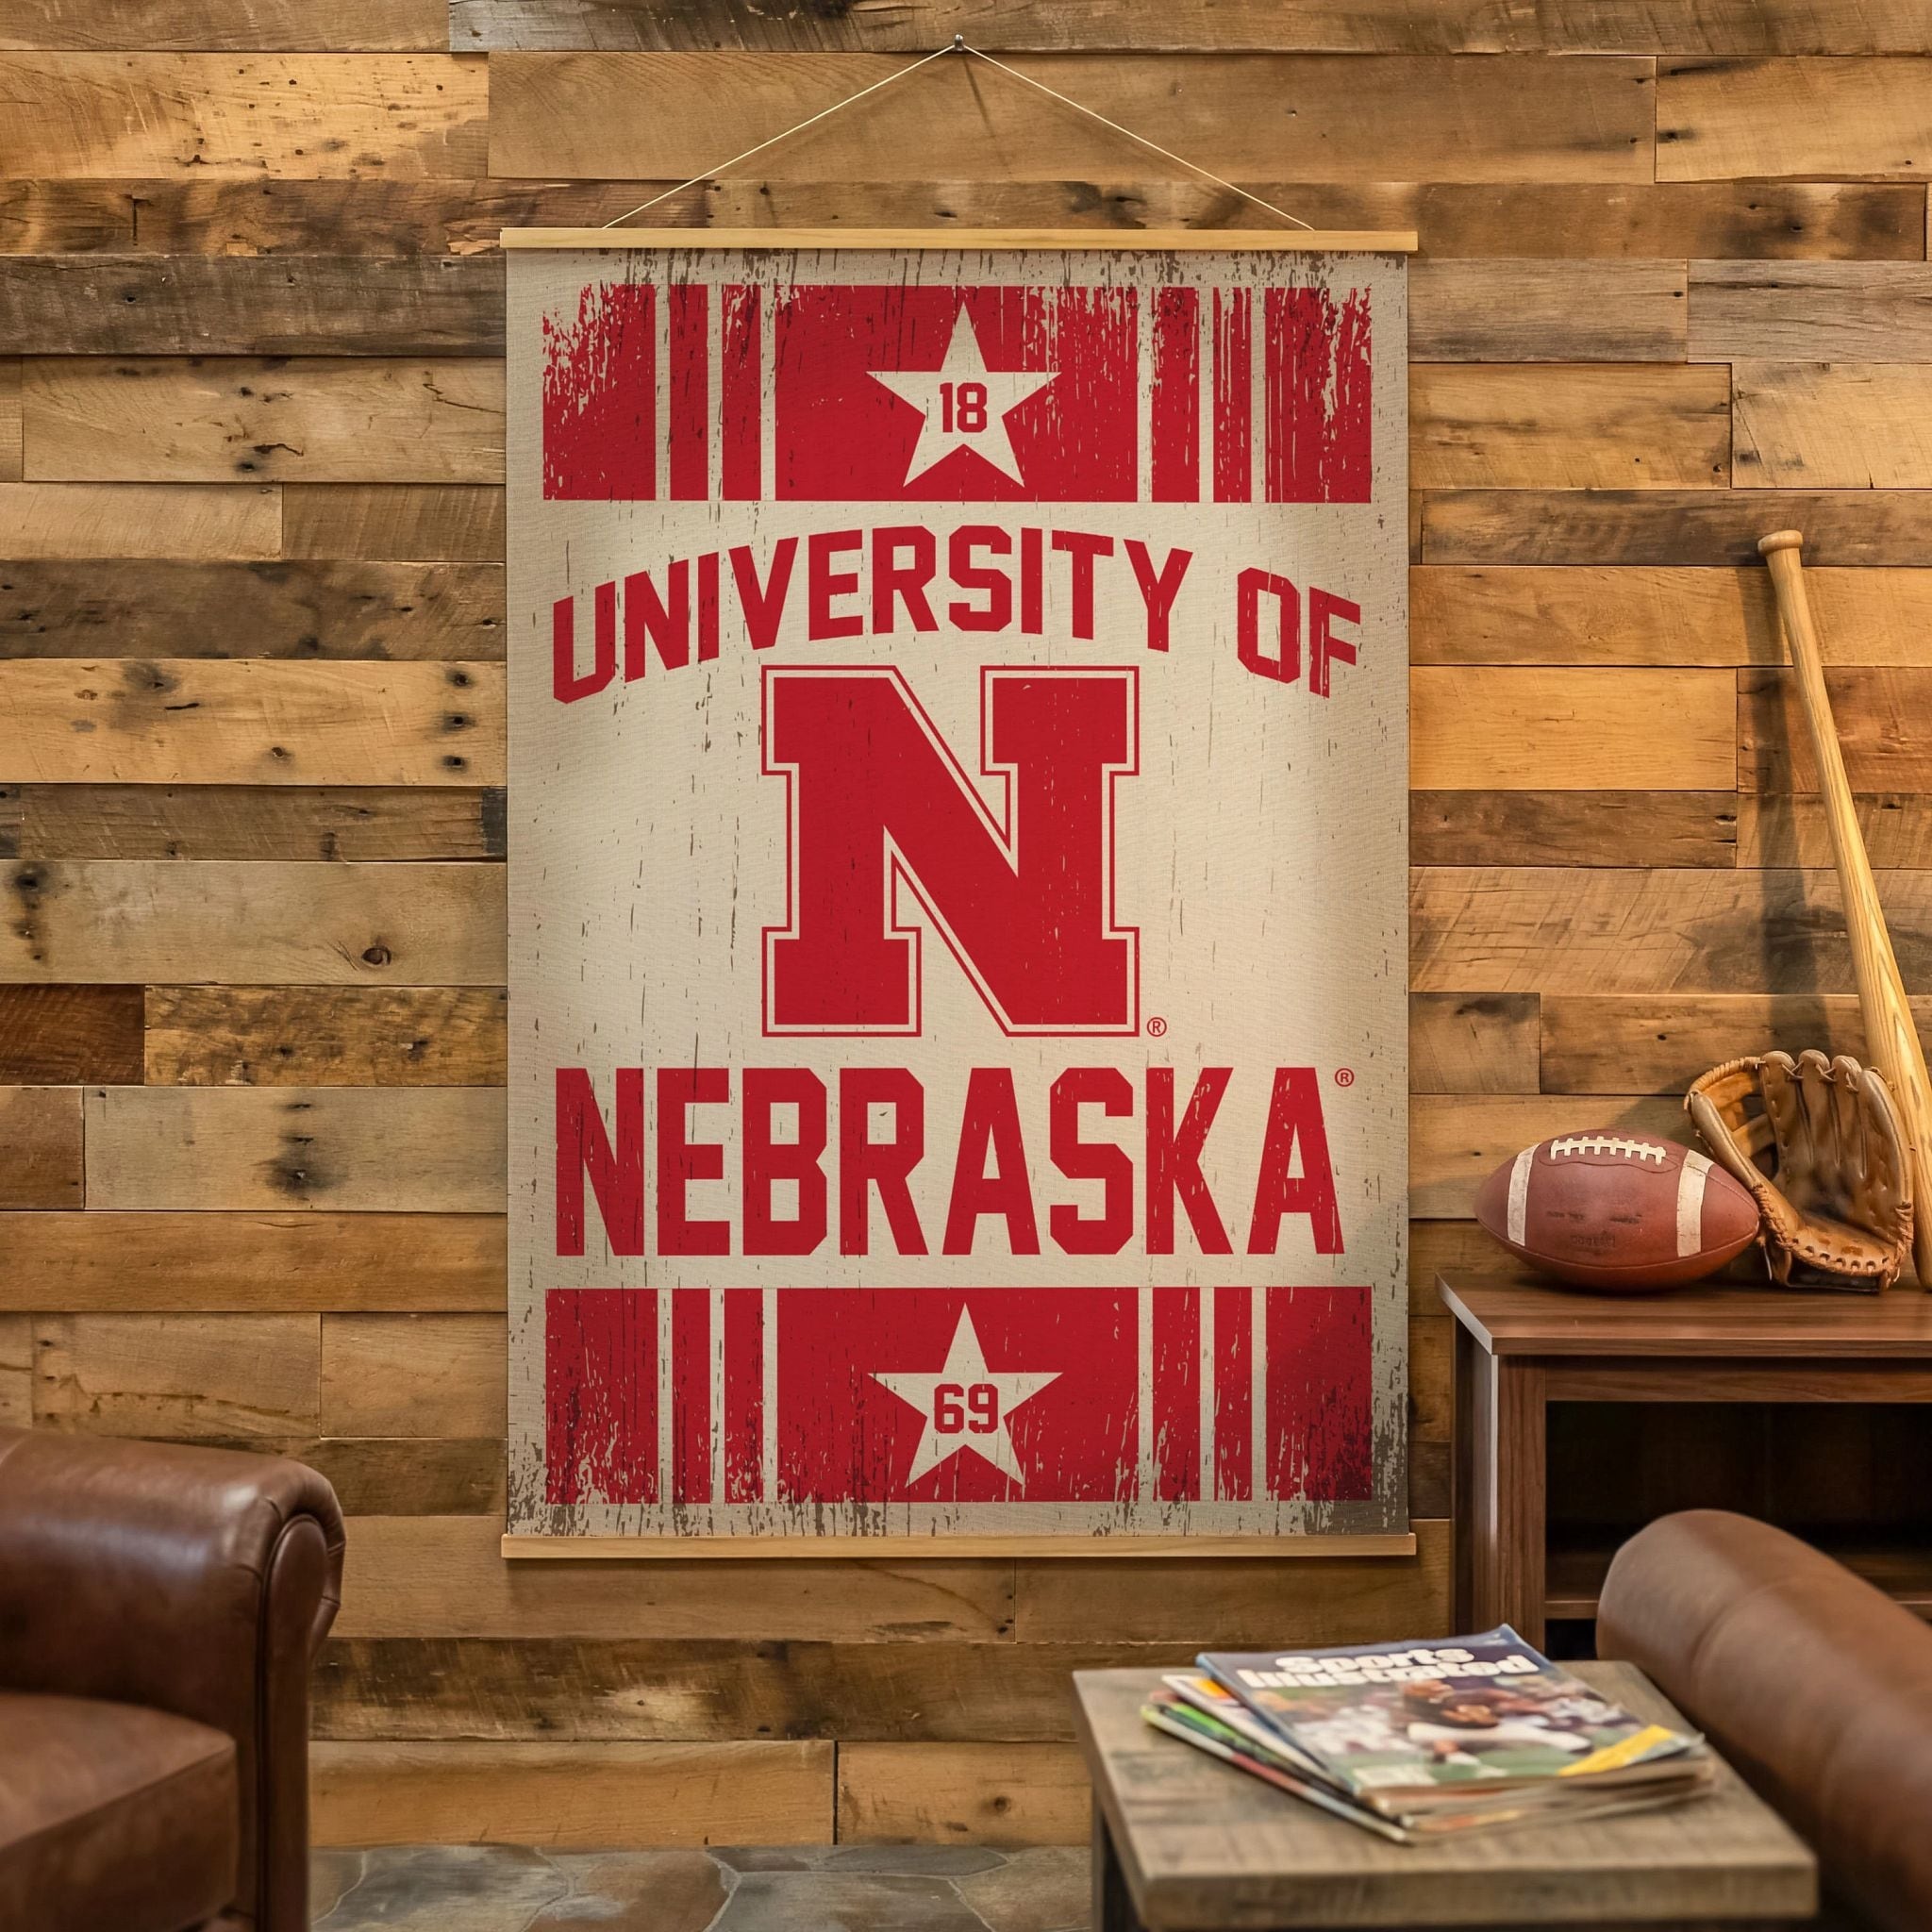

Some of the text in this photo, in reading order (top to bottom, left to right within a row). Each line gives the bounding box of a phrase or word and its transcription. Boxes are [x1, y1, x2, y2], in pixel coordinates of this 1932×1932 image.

[940, 382, 988, 434] 18
[552, 525, 1363, 705] UNIVERSITY OF
[760, 664, 1141, 1038] N
[555, 1067, 1345, 1257] NEBRASKA
[934, 1384, 999, 1435] 69
[1235, 1655, 1541, 1689] Illustrated
[1274, 1647, 1475, 1674] Sports
